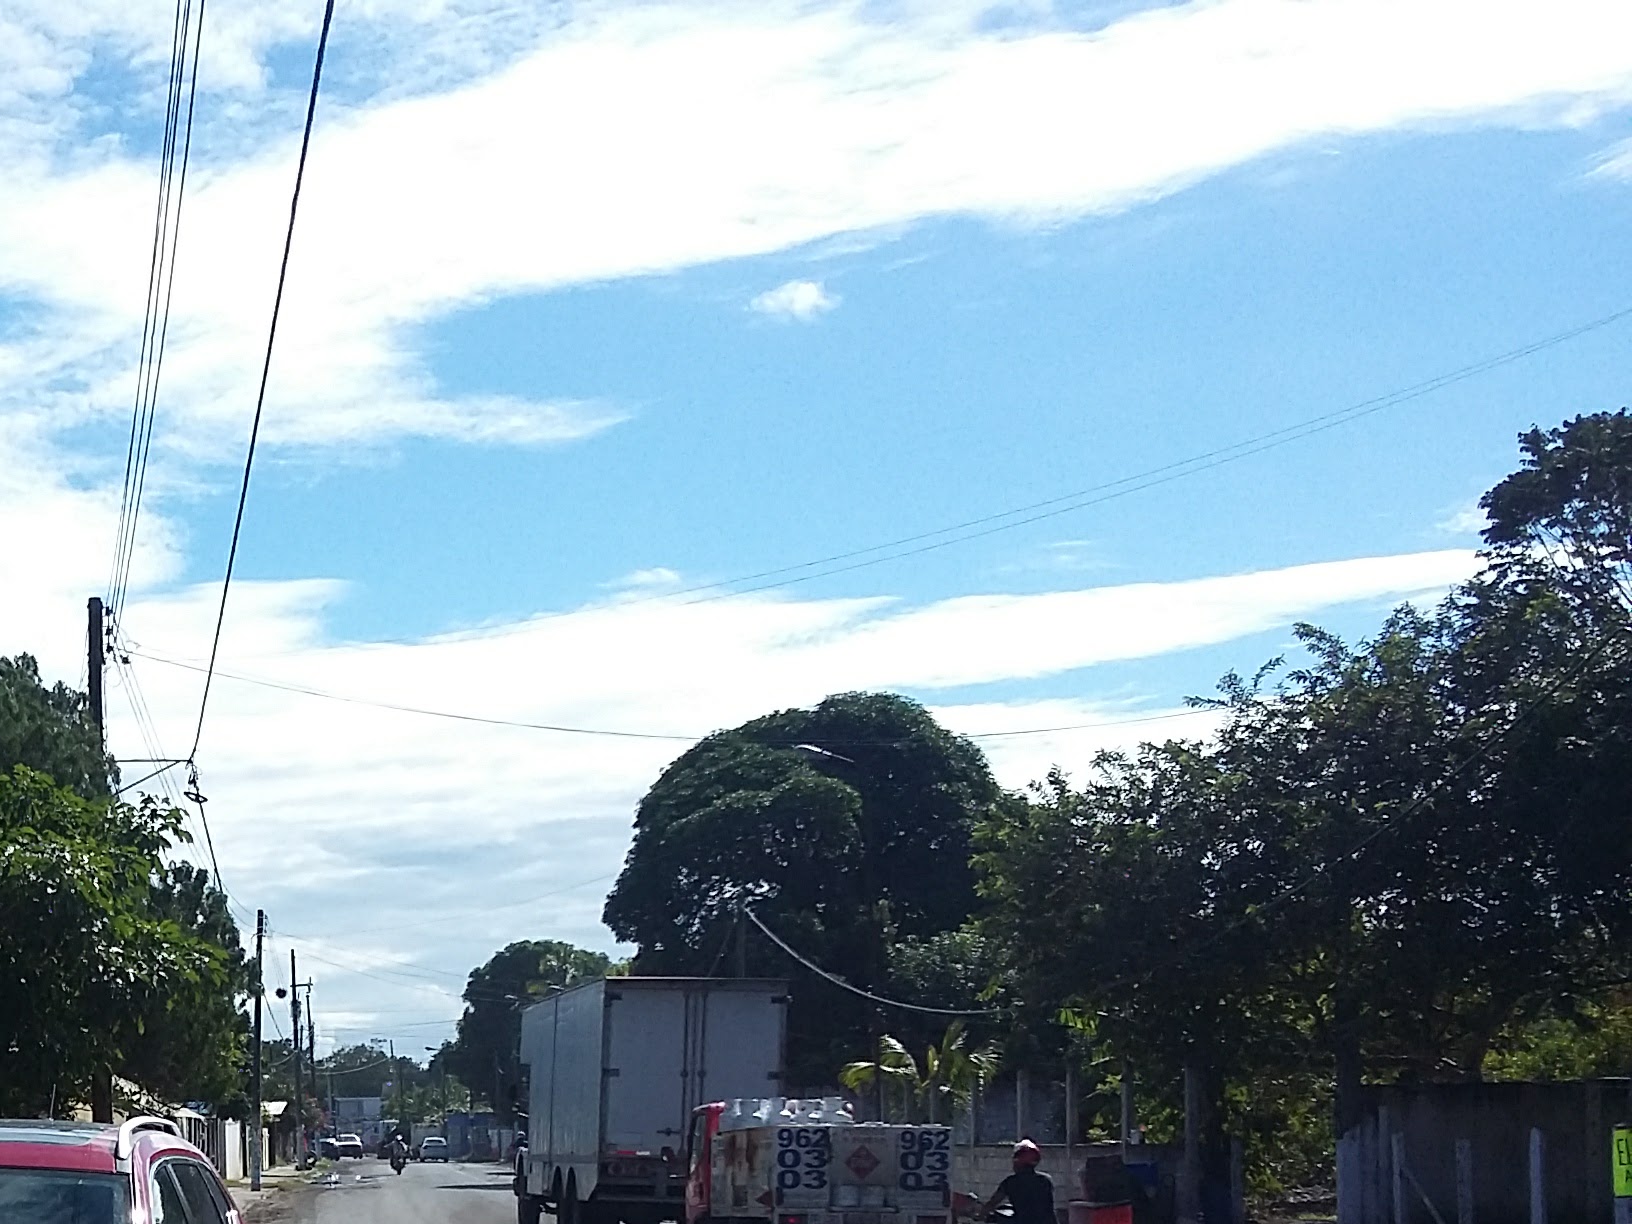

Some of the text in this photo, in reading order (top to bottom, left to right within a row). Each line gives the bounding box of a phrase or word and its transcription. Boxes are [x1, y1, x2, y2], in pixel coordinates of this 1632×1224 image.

[777, 1128, 830, 1149] 962
[900, 1130, 950, 1150] 962
[777, 1149, 829, 1169] 03
[900, 1151, 950, 1171] 03
[776, 1169, 828, 1190] 03
[899, 1172, 950, 1191] 03
